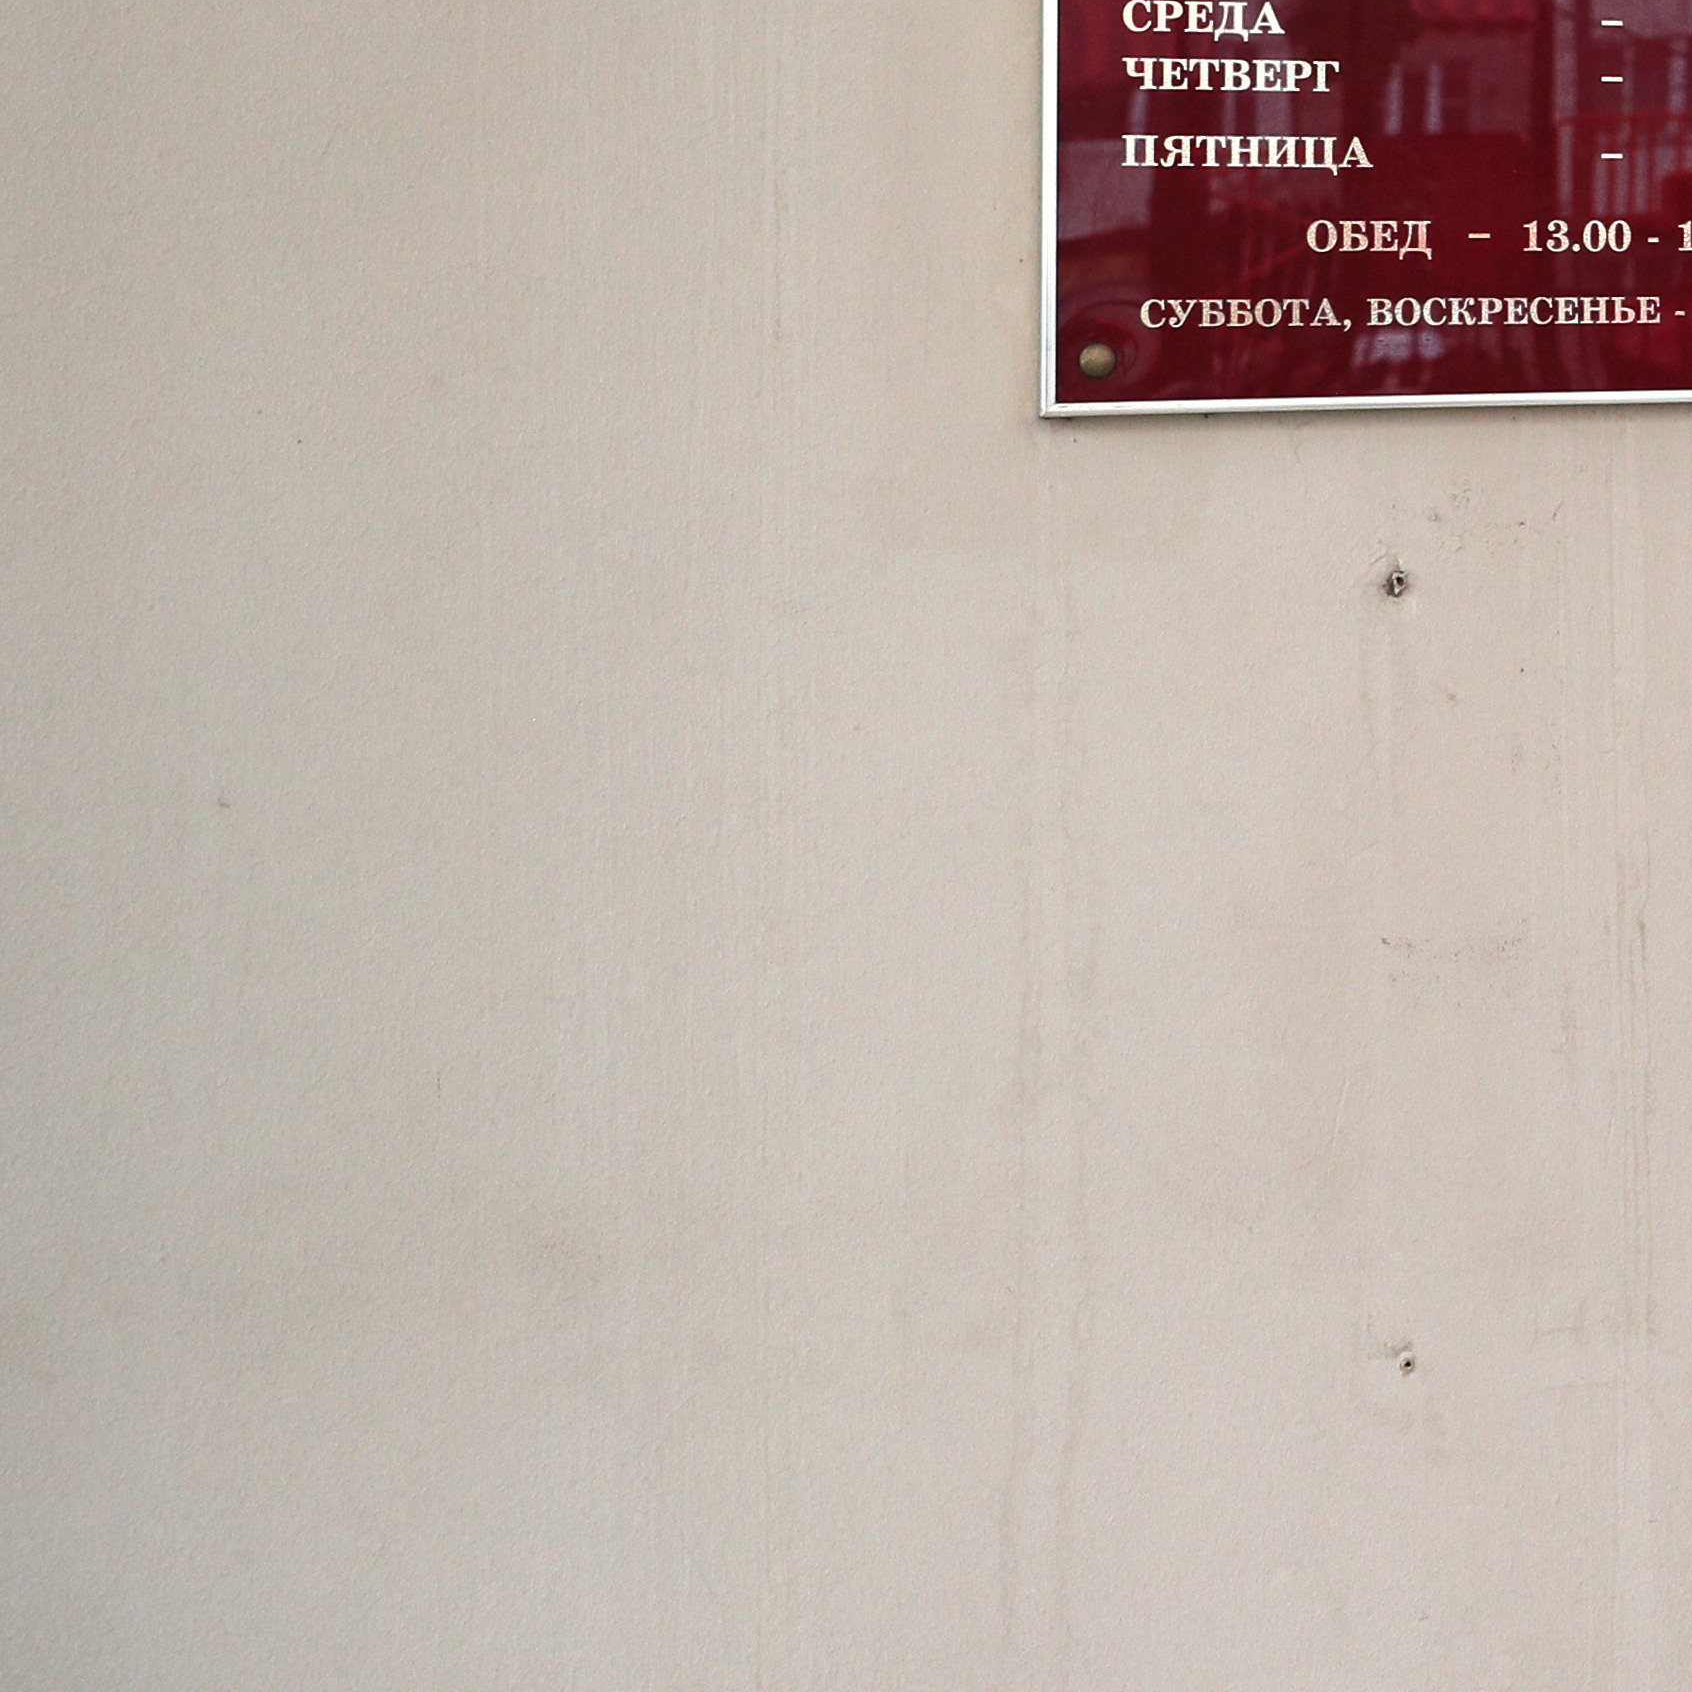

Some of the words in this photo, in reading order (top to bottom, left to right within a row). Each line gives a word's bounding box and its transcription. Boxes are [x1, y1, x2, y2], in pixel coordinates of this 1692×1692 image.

[1121, 57, 1340, 93] ЧЕТВЕРГ
[1121, 134, 1374, 177] ПЯТНИЦА
[1306, 219, 1432, 261] ОБЕД
[1523, 219, 1632, 253] 13.00
[1140, 297, 1352, 332] СУББОТА,
[1366, 296, 1661, 327] ВОСКРЕСЕНЬЕ
